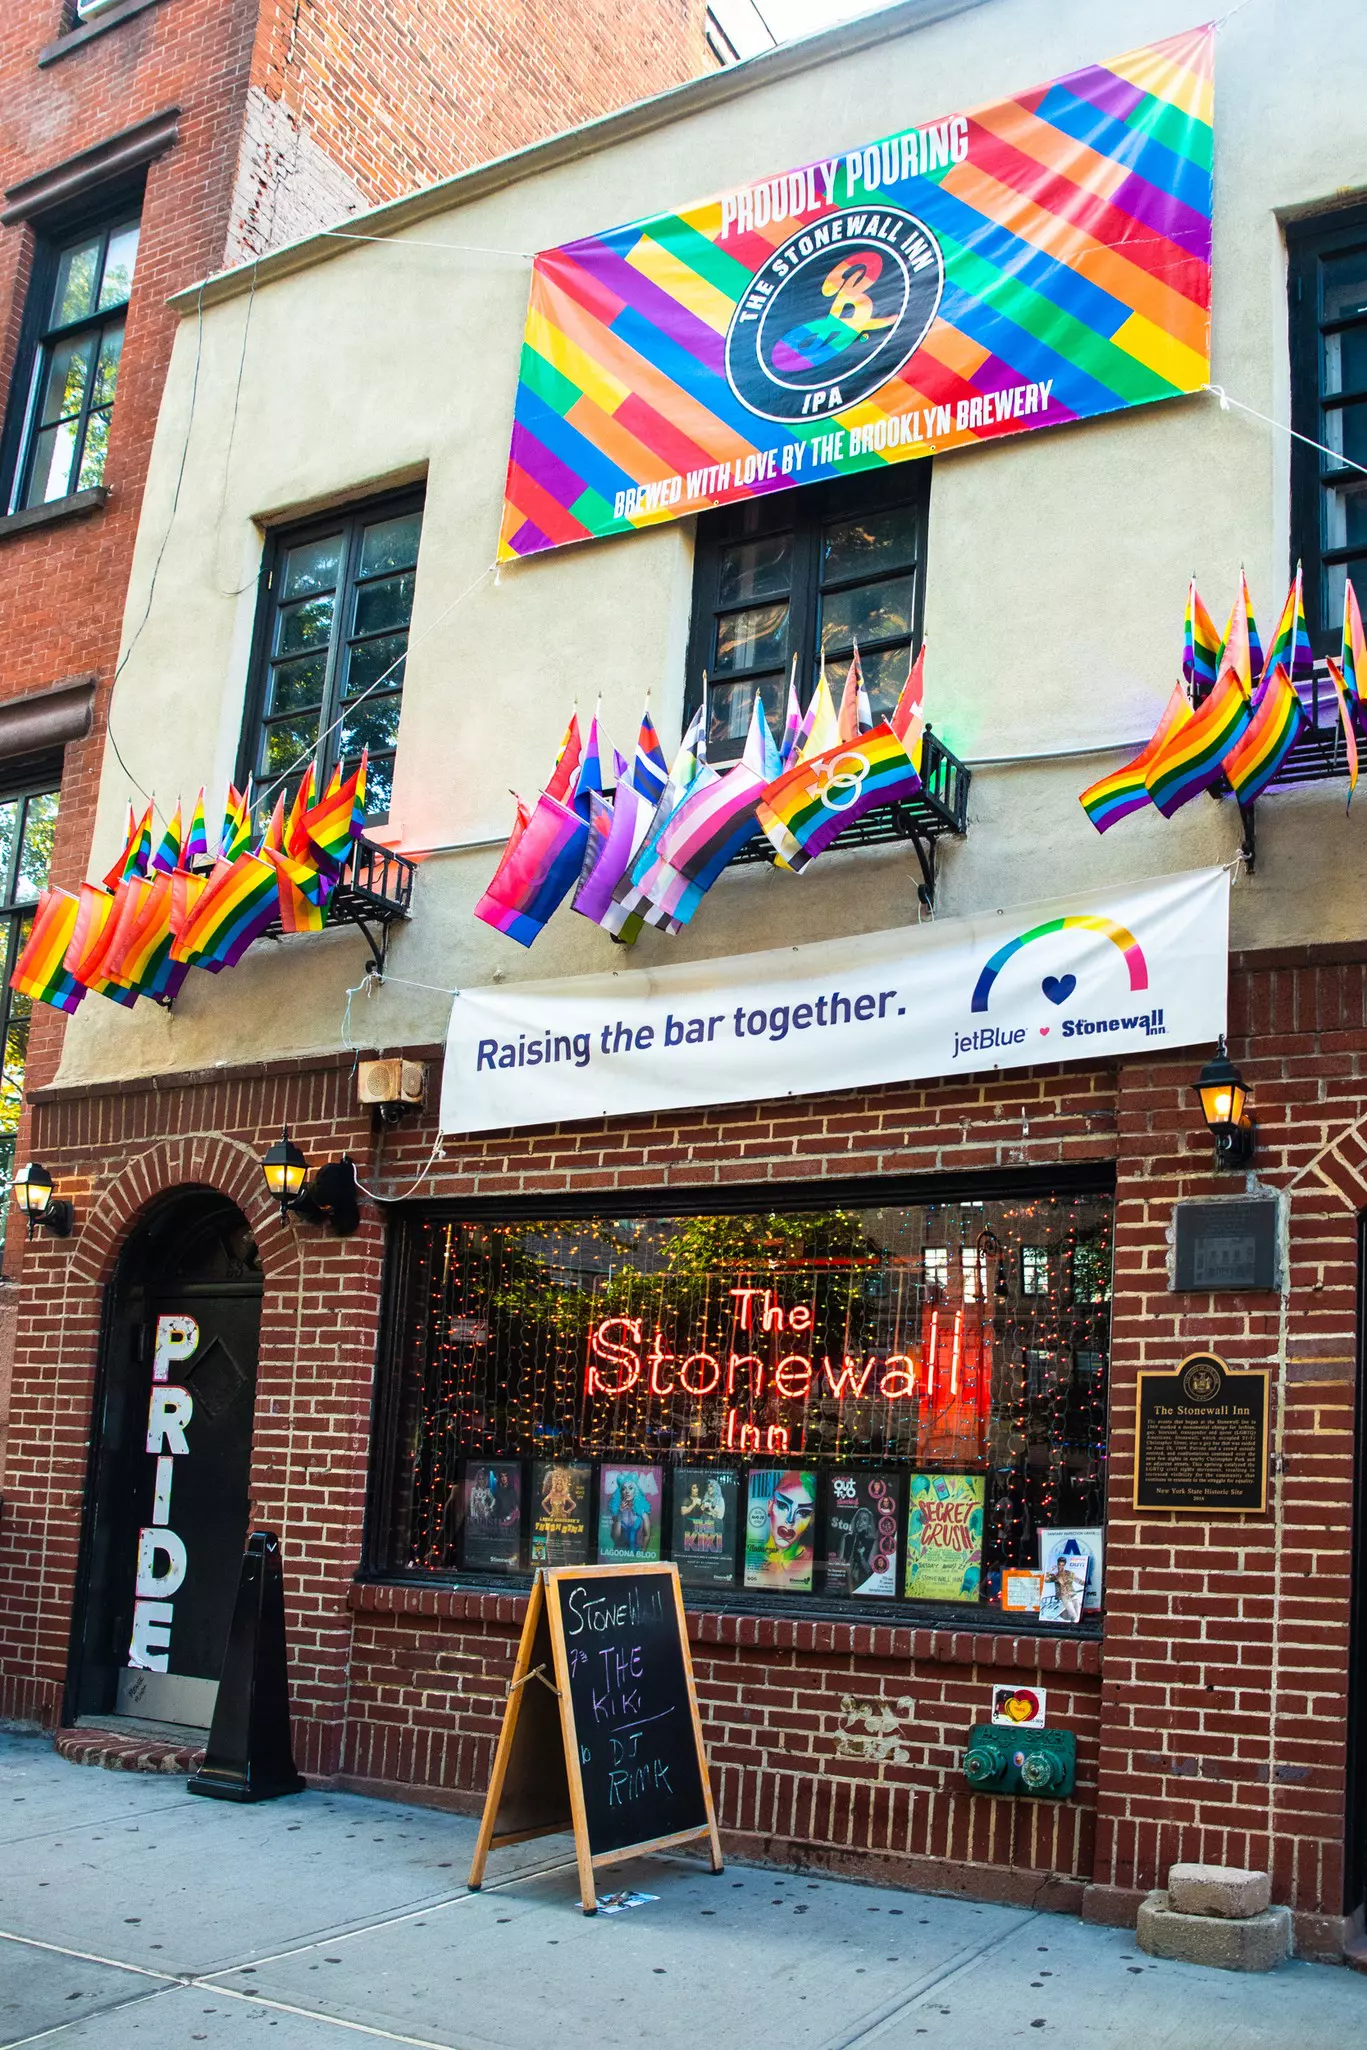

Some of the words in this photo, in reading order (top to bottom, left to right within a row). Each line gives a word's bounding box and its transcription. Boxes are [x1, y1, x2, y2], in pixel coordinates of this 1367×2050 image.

[720, 157, 839, 240] PROUDLY
[846, 115, 969, 199] POURING
[738, 279, 776, 324] THE
[771, 214, 904, 278] STONEWALL
[900, 230, 935, 274] INN
[801, 385, 843, 415] IPA
[613, 474, 683, 519] BREWED
[686, 461, 731, 503] WITH
[733, 448, 778, 487] LOVE
[781, 440, 807, 476] BY
[811, 430, 845, 467] THE
[849, 403, 952, 457] BROOKLYN
[956, 378, 1054, 432] BREWERY
[476, 1029, 591, 1072] Raising
[600, 1020, 655, 1055] the
[663, 1014, 726, 1047] bar
[733, 989, 907, 1042] together.
[1061, 1008, 1164, 1038] Stonewall
[1145, 1023, 1166, 1037] Inn
[952, 1027, 1026, 1059] jetBlue
[730, 1288, 813, 1332] The
[586, 1309, 965, 1400] Stonewall
[1153, 1405, 1174, 1416] The
[1177, 1405, 1228, 1416] Stonewall
[1232, 1405, 1250, 1416] Inn
[726, 1408, 789, 1452] Inn
[128, 1313, 200, 1674] PRIDE
[918, 1500, 980, 1525] SECRET
[600, 1548, 634, 1558] LAGOONA
[636, 1549, 656, 1559] BLOO
[684, 1531, 723, 1553] KIKI
[920, 1524, 974, 1552] CRUSH
[598, 1645, 644, 1693] THE
[592, 1687, 642, 1723] KIKI
[609, 1731, 643, 1767] DJ
